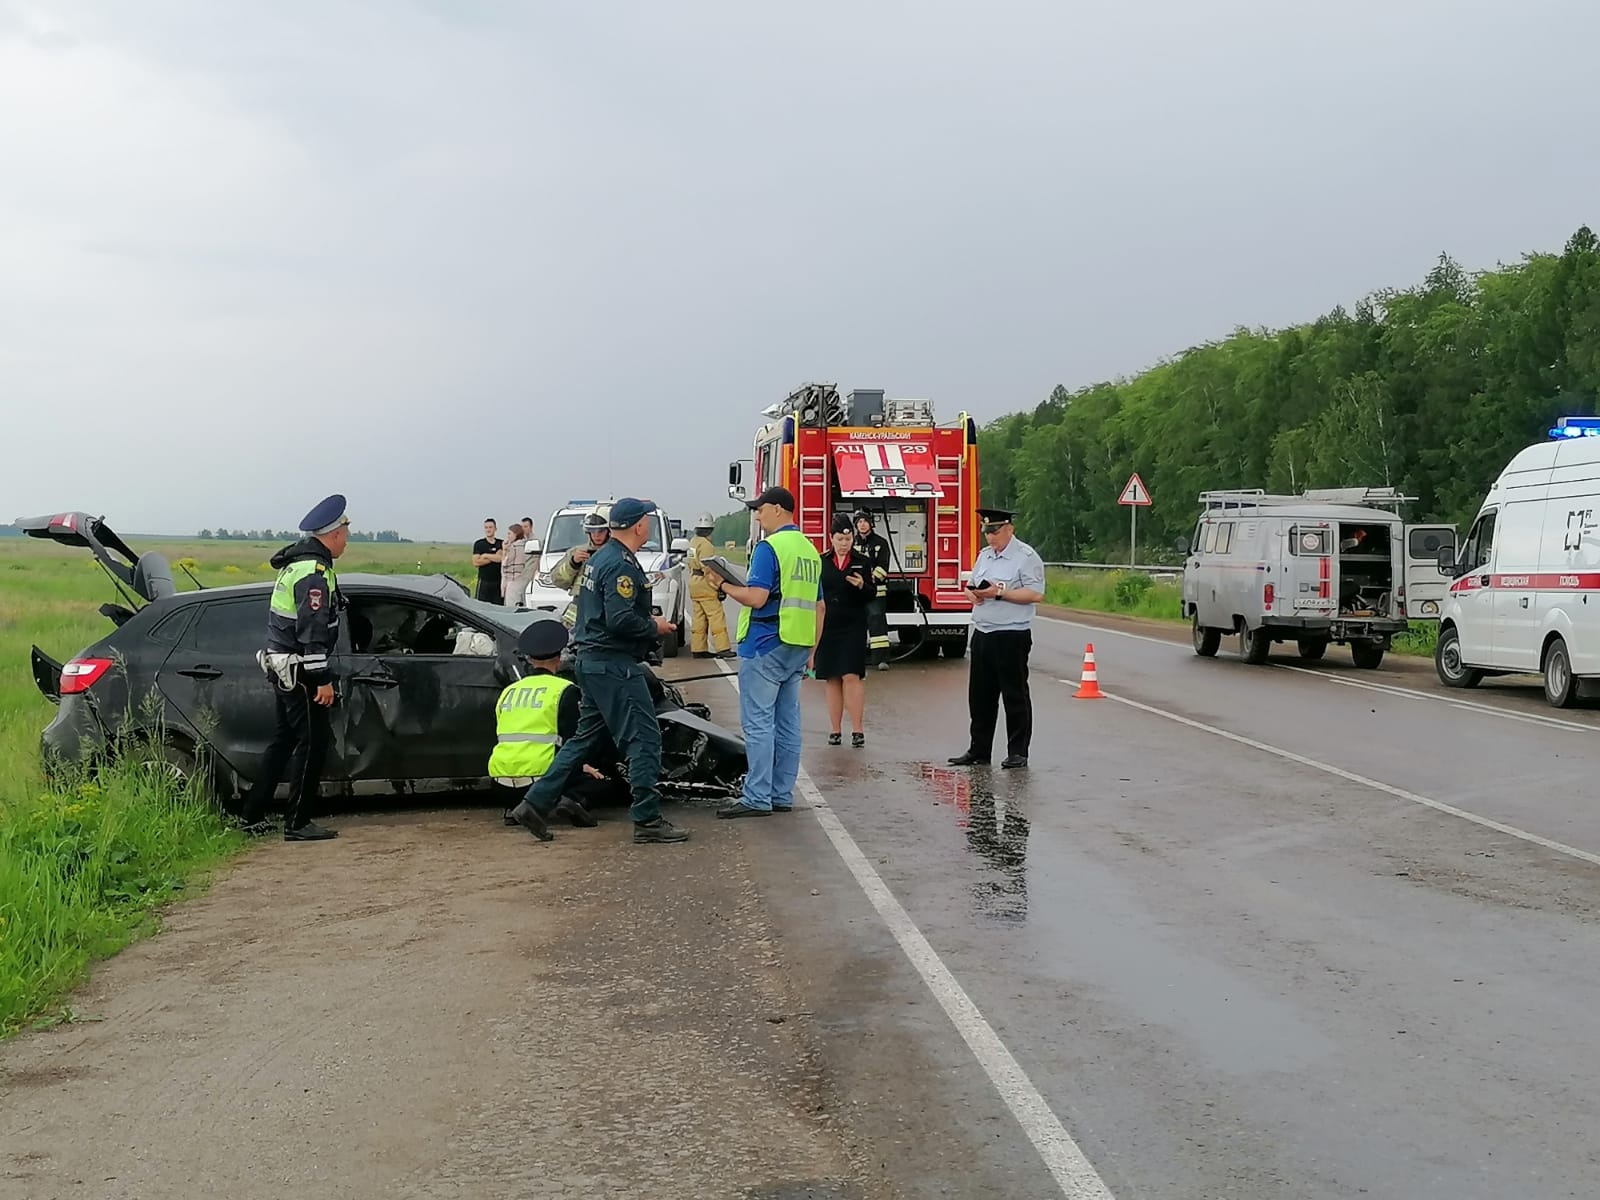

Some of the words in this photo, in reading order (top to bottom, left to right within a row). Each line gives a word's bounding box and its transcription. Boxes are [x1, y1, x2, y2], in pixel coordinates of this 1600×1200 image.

[834, 445, 864, 454] АЦ
[902, 445, 928, 454] 29
[499, 687, 547, 713] ДПС
